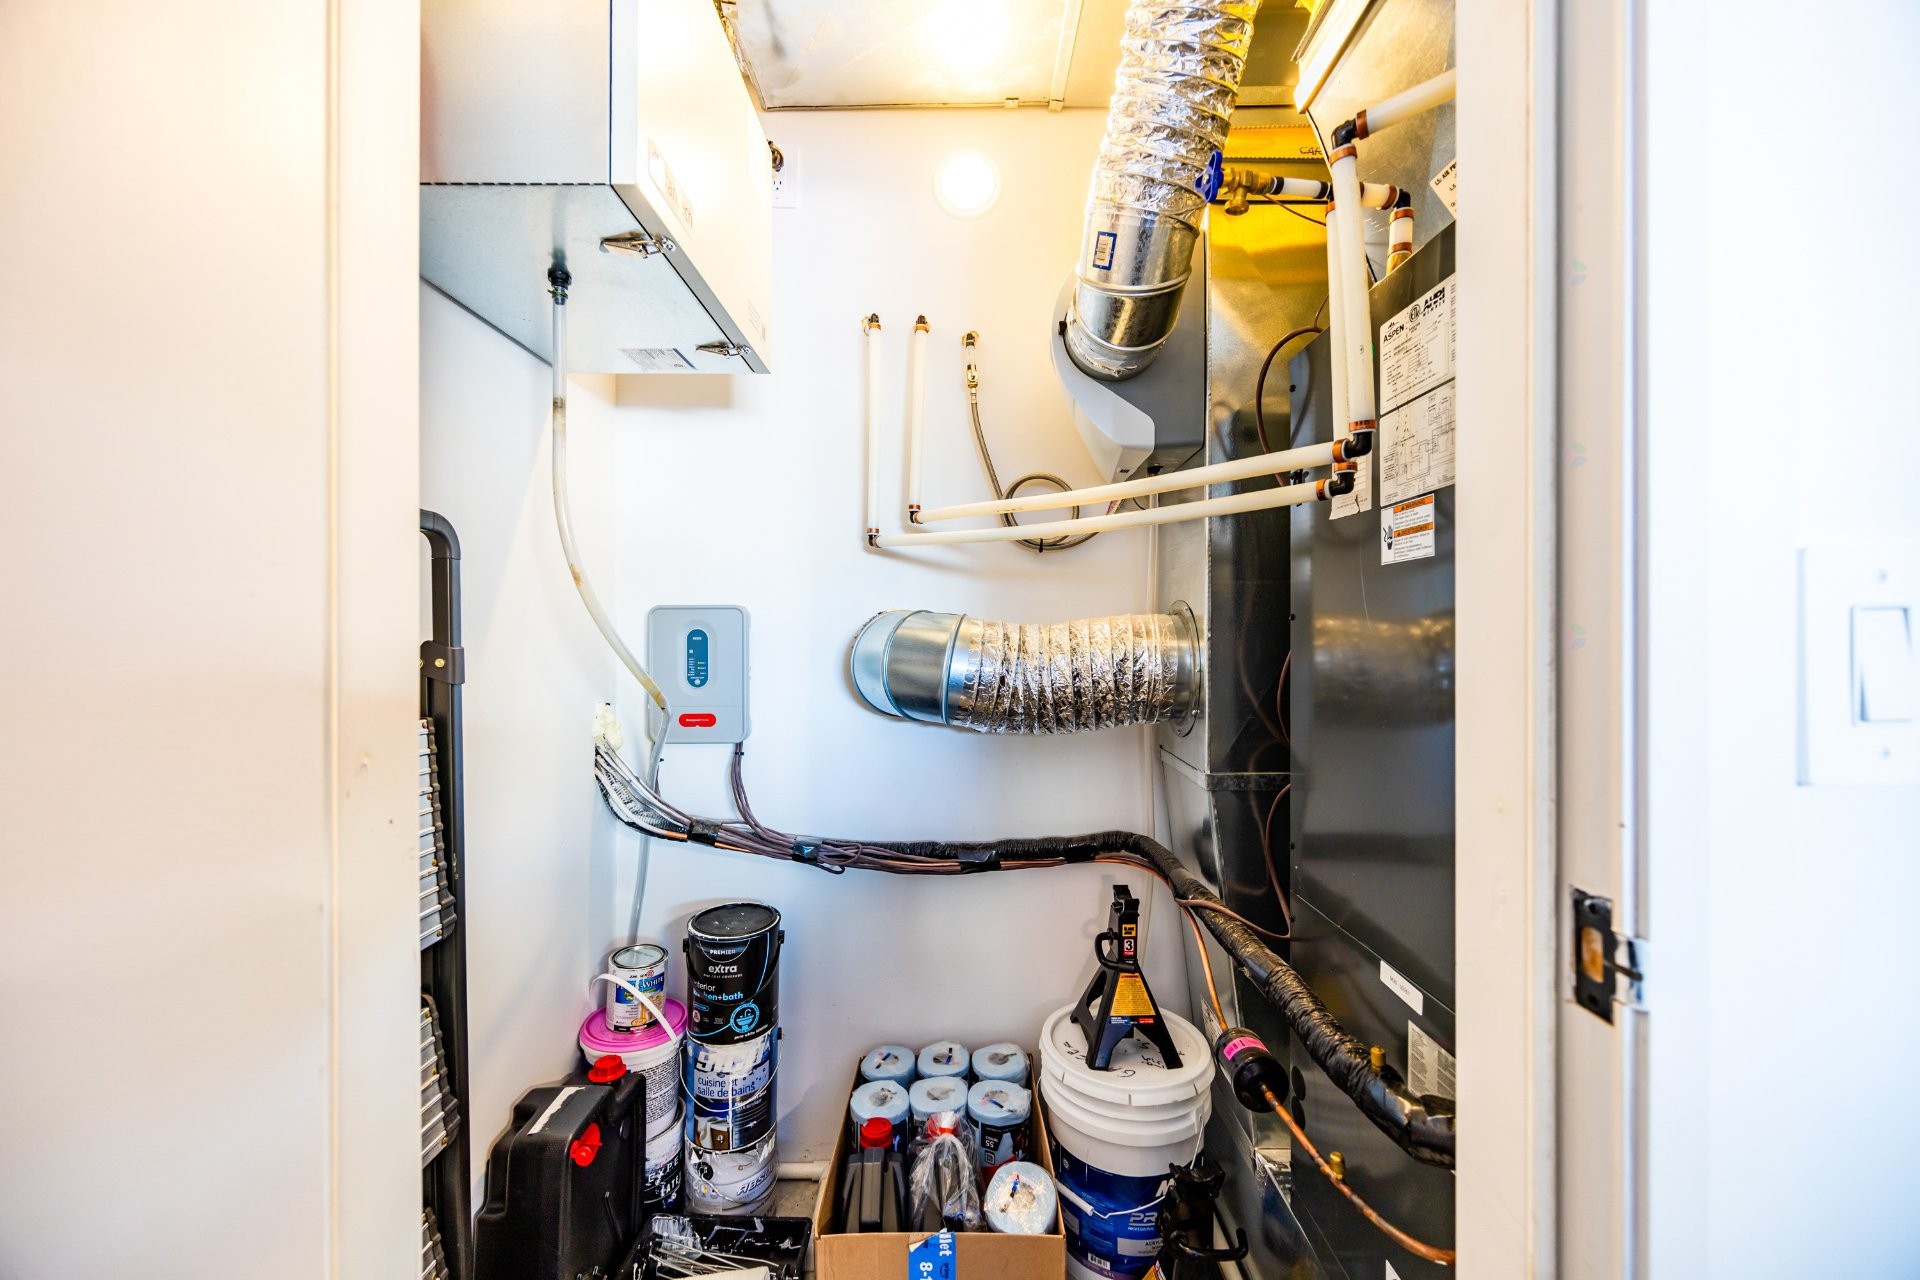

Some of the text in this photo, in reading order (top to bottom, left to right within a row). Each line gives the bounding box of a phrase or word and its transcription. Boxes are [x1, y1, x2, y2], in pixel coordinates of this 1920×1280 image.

[1383, 323, 1405, 343] ASPEN
[1125, 940, 1133, 951] 3
[708, 964, 738, 974] extra
[697, 1076, 726, 1088] cuisine
[697, 1083, 756, 1098] salle de bains
